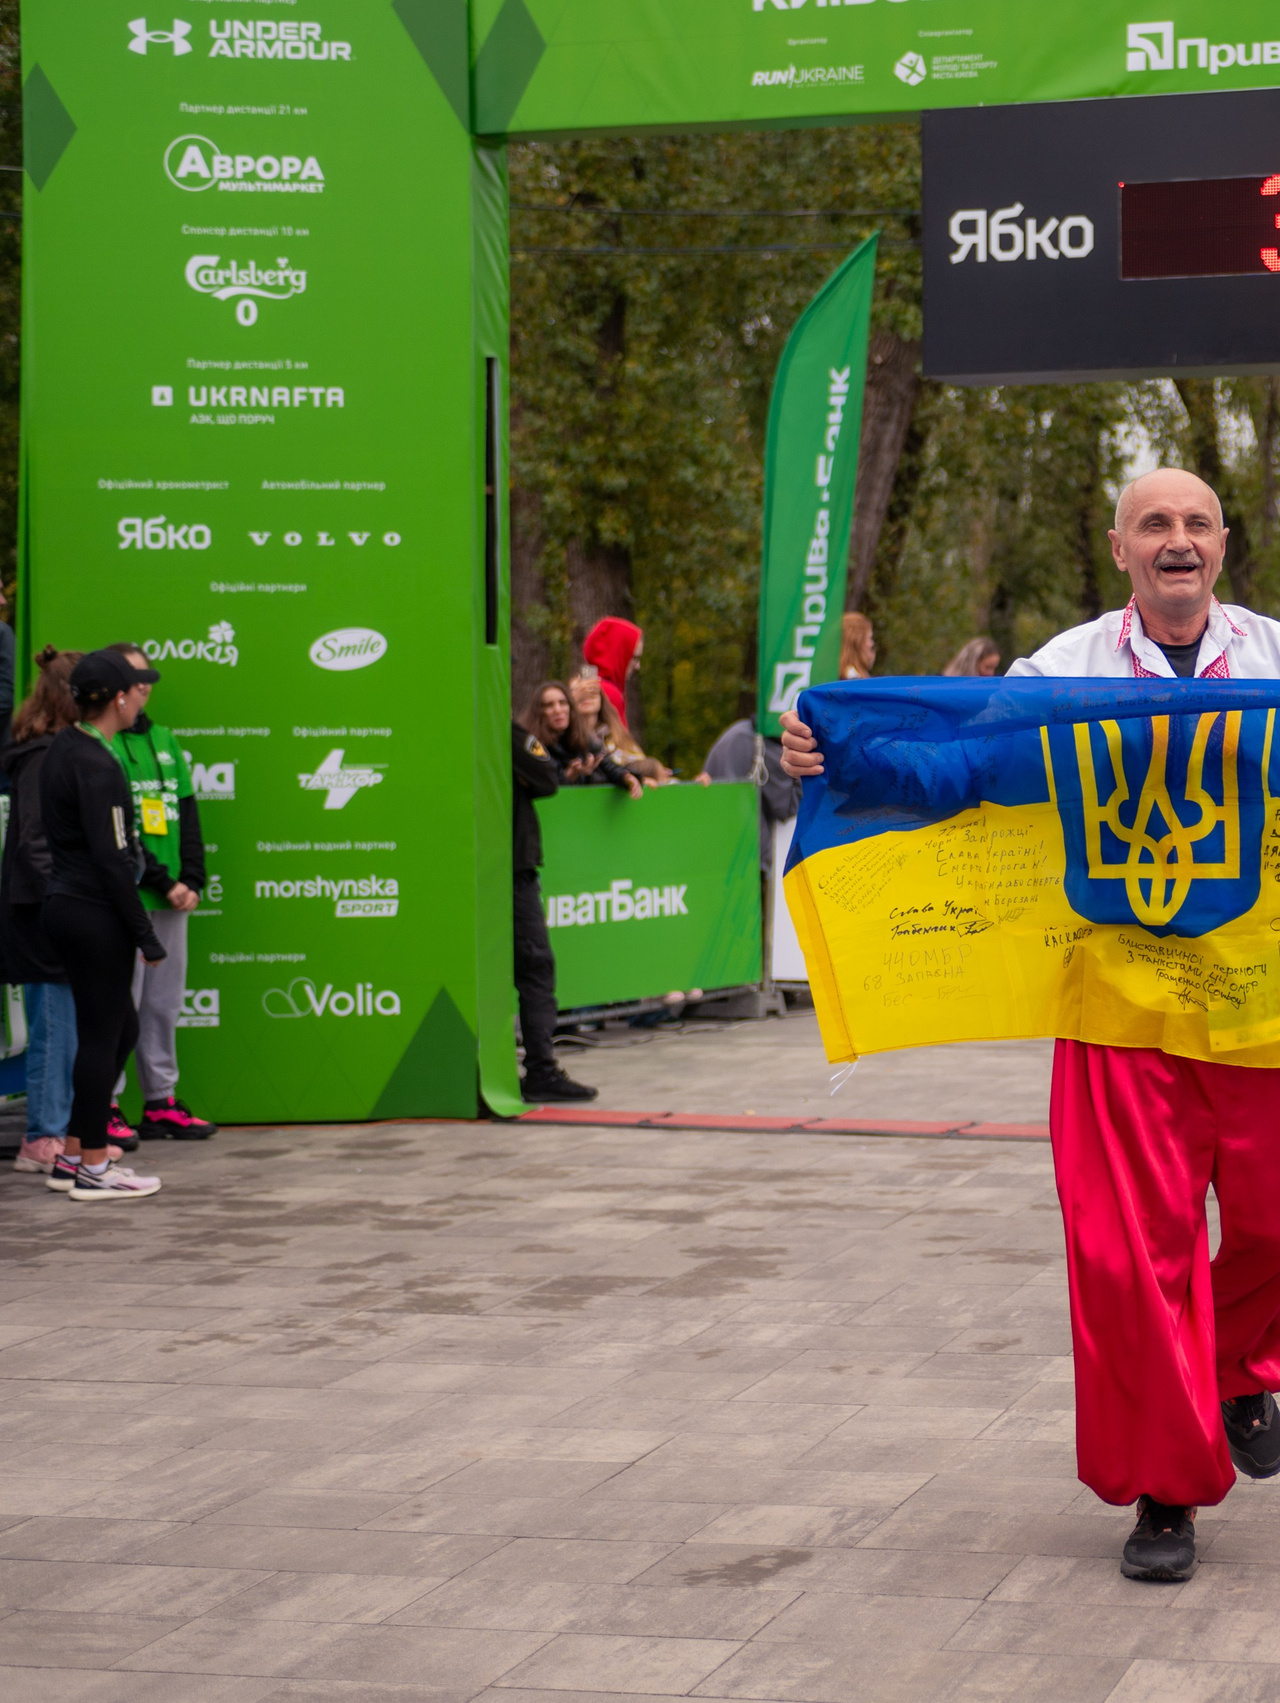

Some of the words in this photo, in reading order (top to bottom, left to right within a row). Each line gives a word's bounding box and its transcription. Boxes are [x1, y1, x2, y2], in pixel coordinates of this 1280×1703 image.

[209, 20, 322, 41] UNDER
[208, 41, 353, 61] ARMOUR
[179, 103, 225, 115] Партнер
[228, 104, 276, 117] дистанції
[278, 105, 291, 115] 21
[293, 107, 308, 115] км
[218, 181, 325, 194] МУЛЬТИМАРКЕТ
[181, 225, 226, 237] Спонсор
[281, 226, 294, 236] 10
[948, 202, 1095, 264] Ябко
[185, 254, 307, 301] Carlsberg
[187, 358, 230, 371] Партнер
[285, 359, 293, 369] 5
[188, 385, 345, 408] UKRNAFTA
[118, 514, 212, 550] Ябко
[248, 530, 402, 548] VOLVO
[316, 635, 381, 662] Smile
[255, 874, 399, 901] morshynska
[339, 902, 397, 914] SPORT
[546, 878, 689, 929] ватБанк
[303, 981, 400, 1017] Volia
